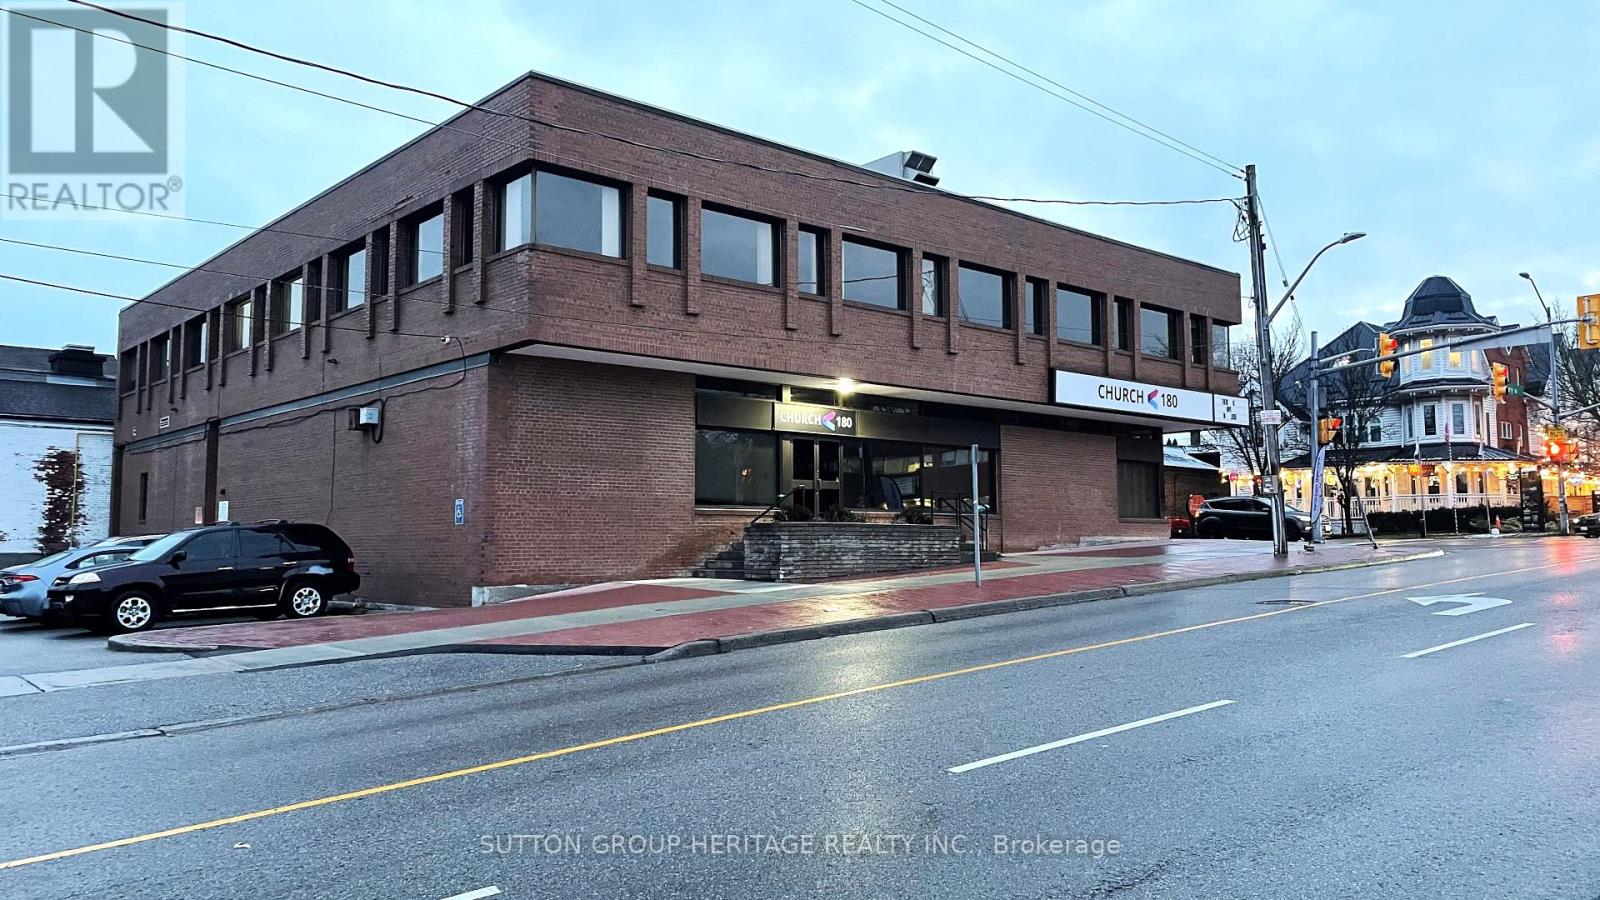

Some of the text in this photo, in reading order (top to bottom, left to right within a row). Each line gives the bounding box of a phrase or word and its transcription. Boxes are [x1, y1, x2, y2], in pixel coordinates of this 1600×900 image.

[1098, 384, 1178, 408] CHURCH 180
[780, 411, 853, 428] CHURCH 180
